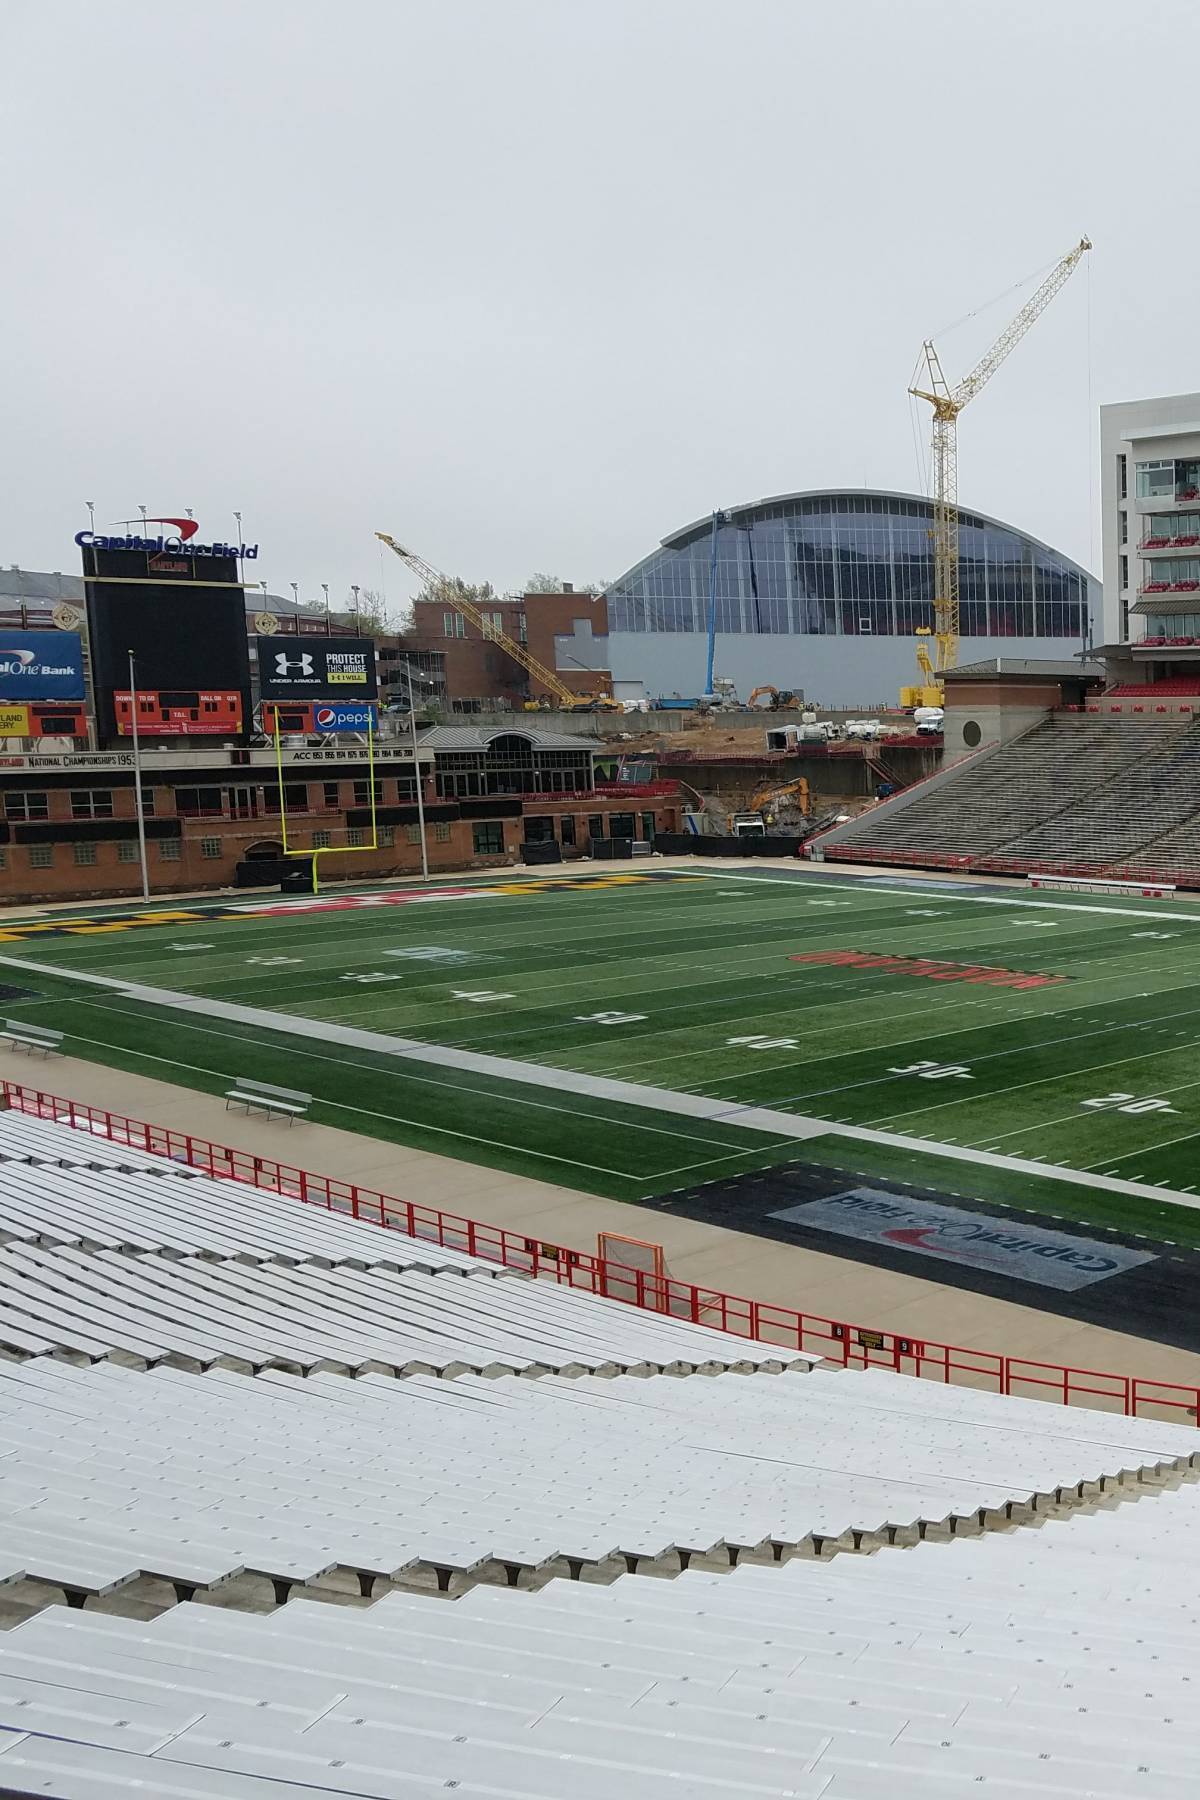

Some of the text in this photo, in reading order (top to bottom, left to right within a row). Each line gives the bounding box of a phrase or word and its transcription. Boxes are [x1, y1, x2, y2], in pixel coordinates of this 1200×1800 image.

[326, 653, 367, 664] PROTECT
[41, 666, 76, 675] Bank
[327, 665, 342, 673] THIS
[292, 752, 311, 760] ACC
[886, 1060, 972, 1079] 30
[1080, 1092, 1172, 1114] 20
[901, 1341, 908, 1351] 9
